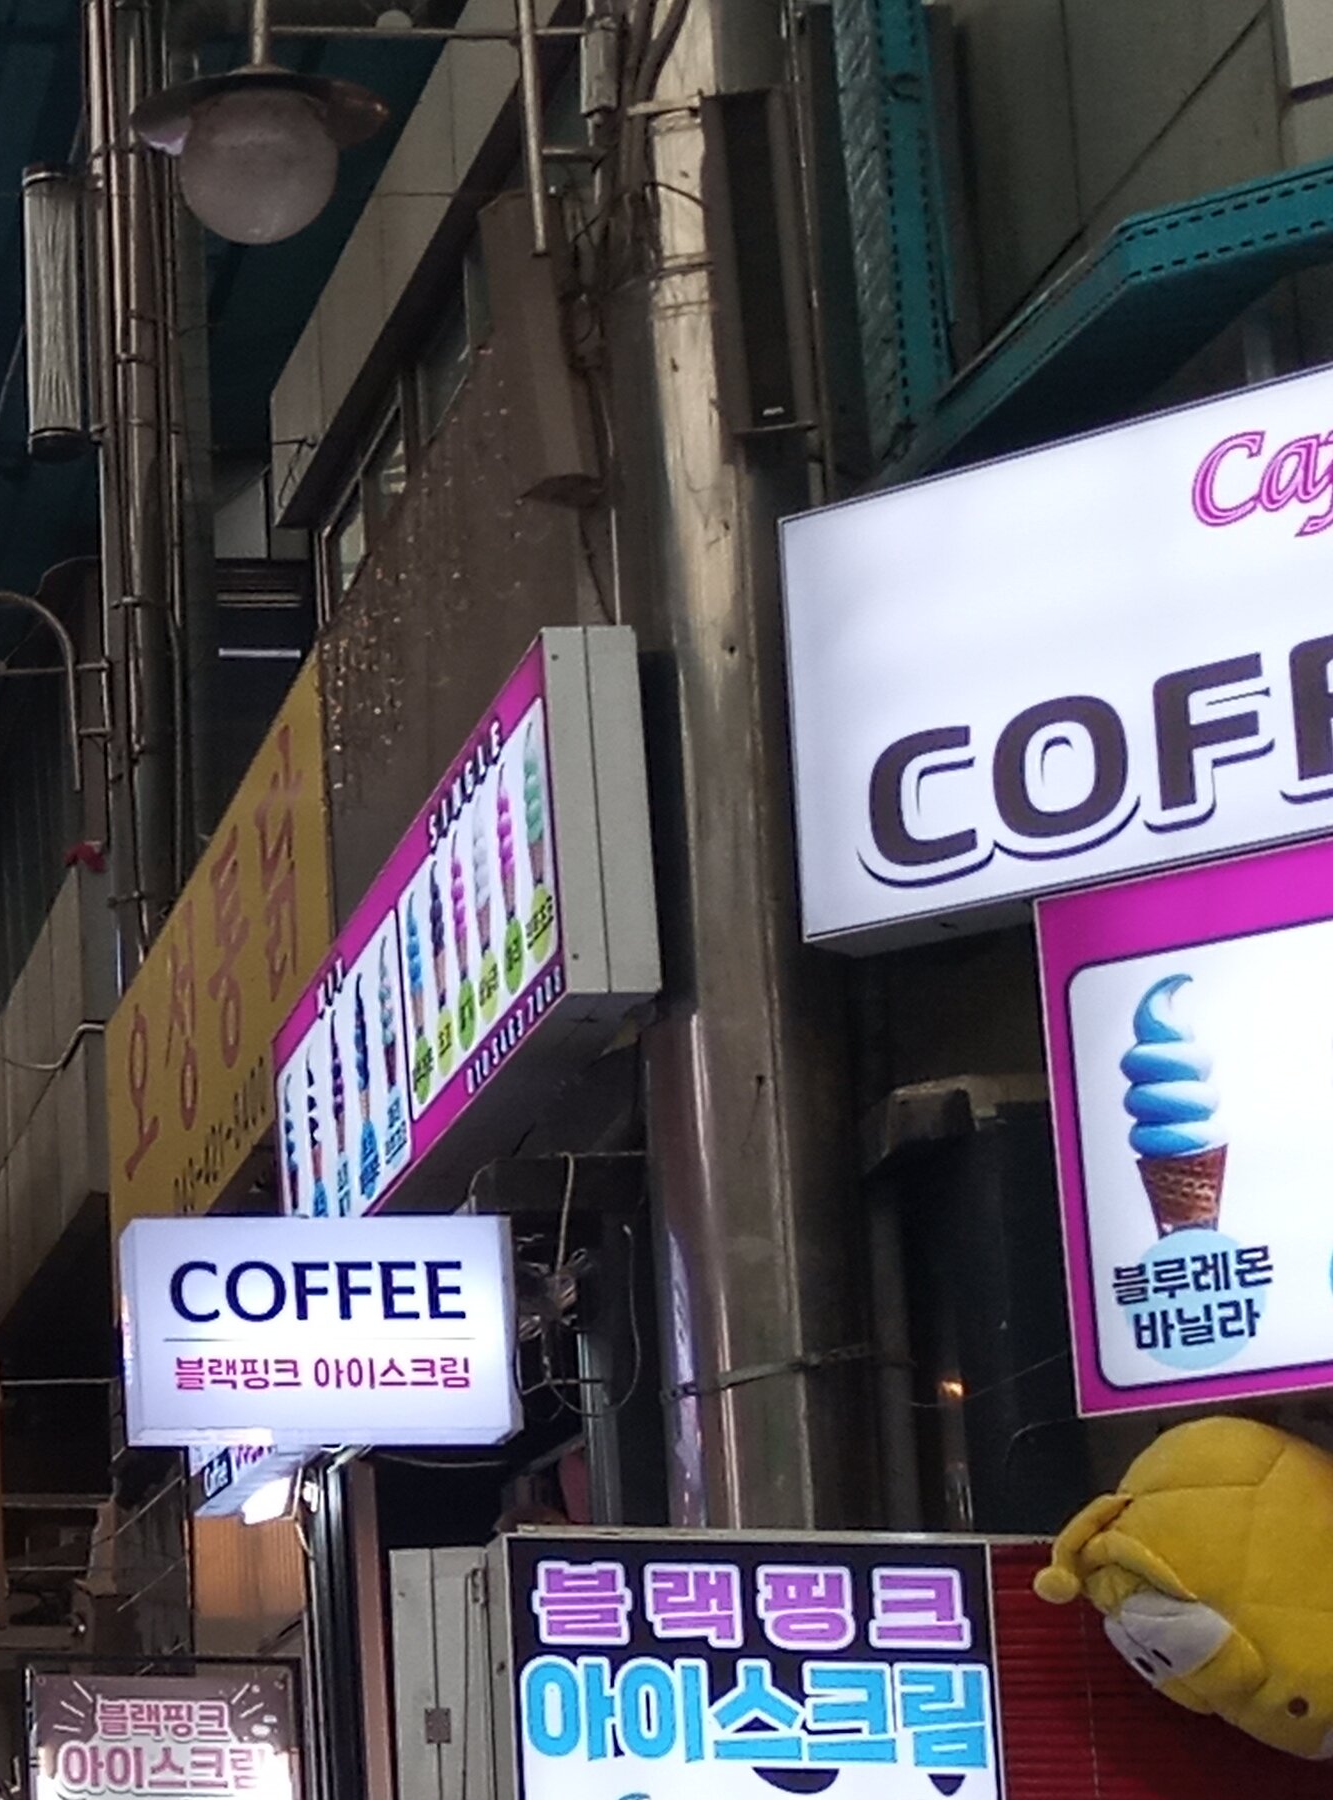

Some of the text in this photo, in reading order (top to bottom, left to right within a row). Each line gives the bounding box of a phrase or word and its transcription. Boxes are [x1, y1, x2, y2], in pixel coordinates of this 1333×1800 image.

[169, 1260, 466, 1322] COFFEE
[1111, 1245, 1274, 1305] 블루레몬
[1133, 1298, 1260, 1350] 바닐라
[174, 1356, 472, 1391] 블랙핑크 아이스크림
[533, 1562, 973, 1650] 블랙핑크
[98, 1702, 230, 1737] 블랙핑크
[521, 1657, 991, 1769] 아이스크림
